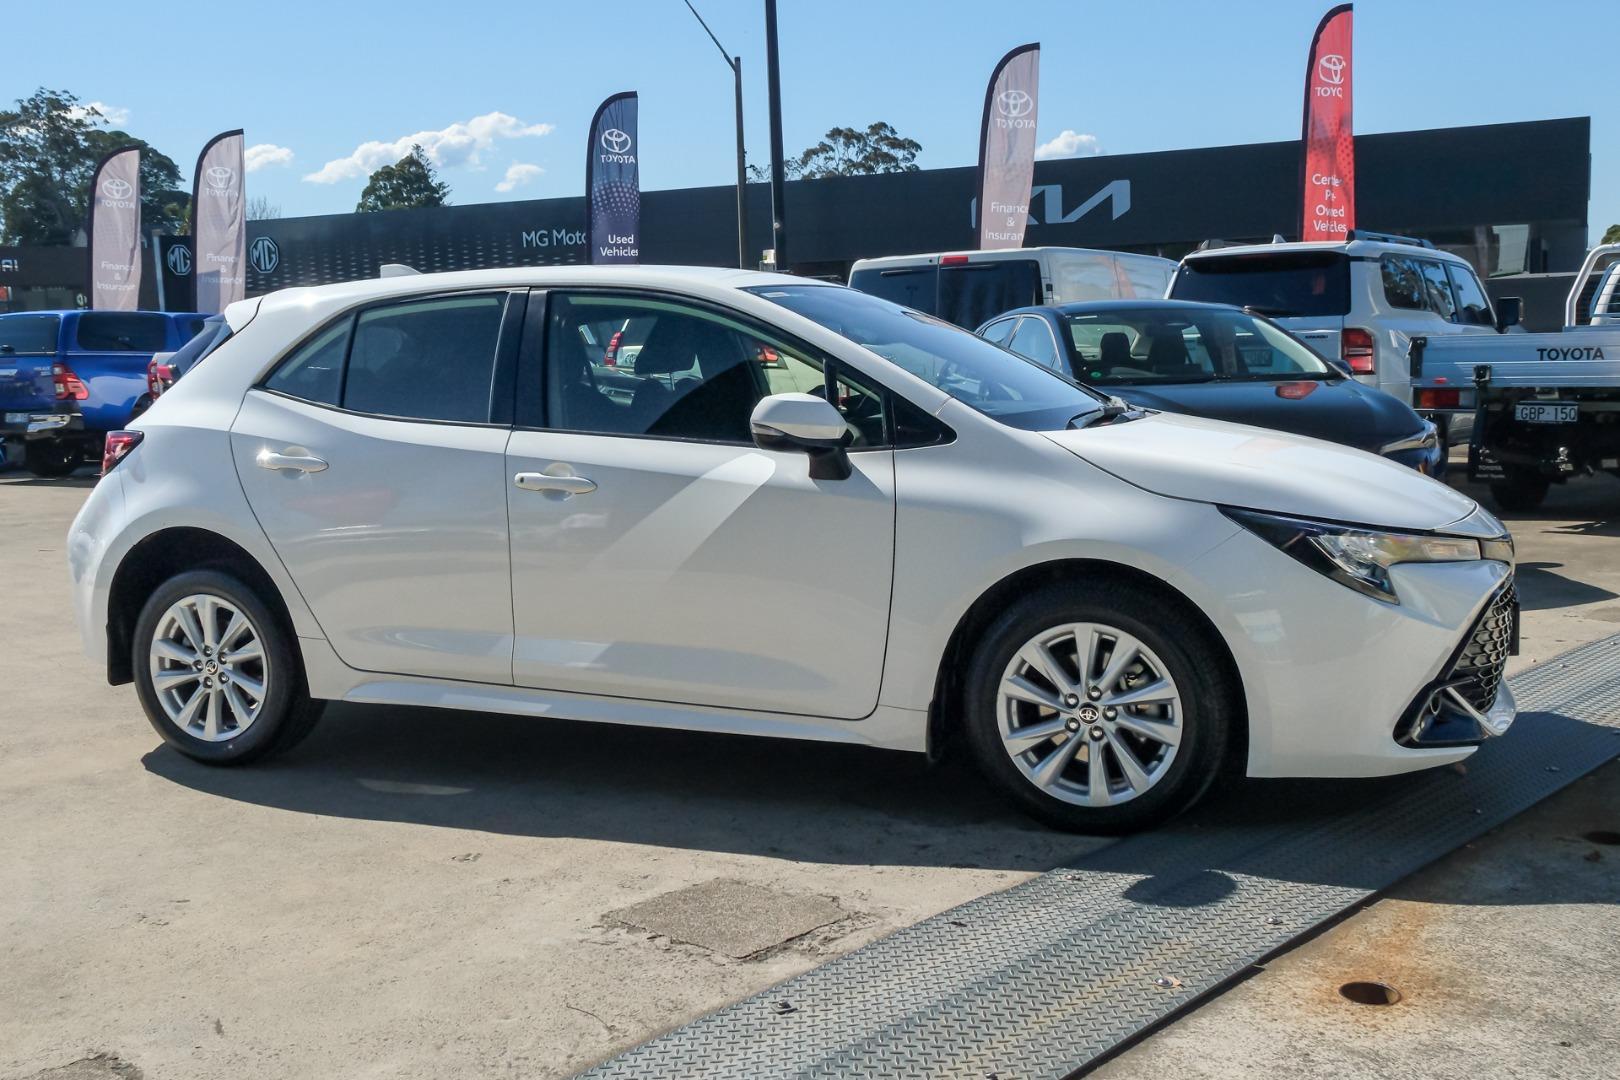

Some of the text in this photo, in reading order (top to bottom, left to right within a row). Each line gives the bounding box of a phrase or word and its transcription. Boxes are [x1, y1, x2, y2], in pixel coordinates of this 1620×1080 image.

[996, 118, 1036, 129] TOYOTA
[601, 154, 636, 164] TOYOTA
[101, 199, 135, 209] TOYOTA
[1006, 216, 1015, 227] &
[522, 228, 587, 247] MG Moto
[608, 234, 634, 244] Used
[985, 229, 1024, 241] Insuran
[600, 246, 639, 257] Vehicles
[168, 246, 192, 274] MG
[1537, 348, 1605, 361] TOYOTA
[1520, 406, 1545, 420] GBP
